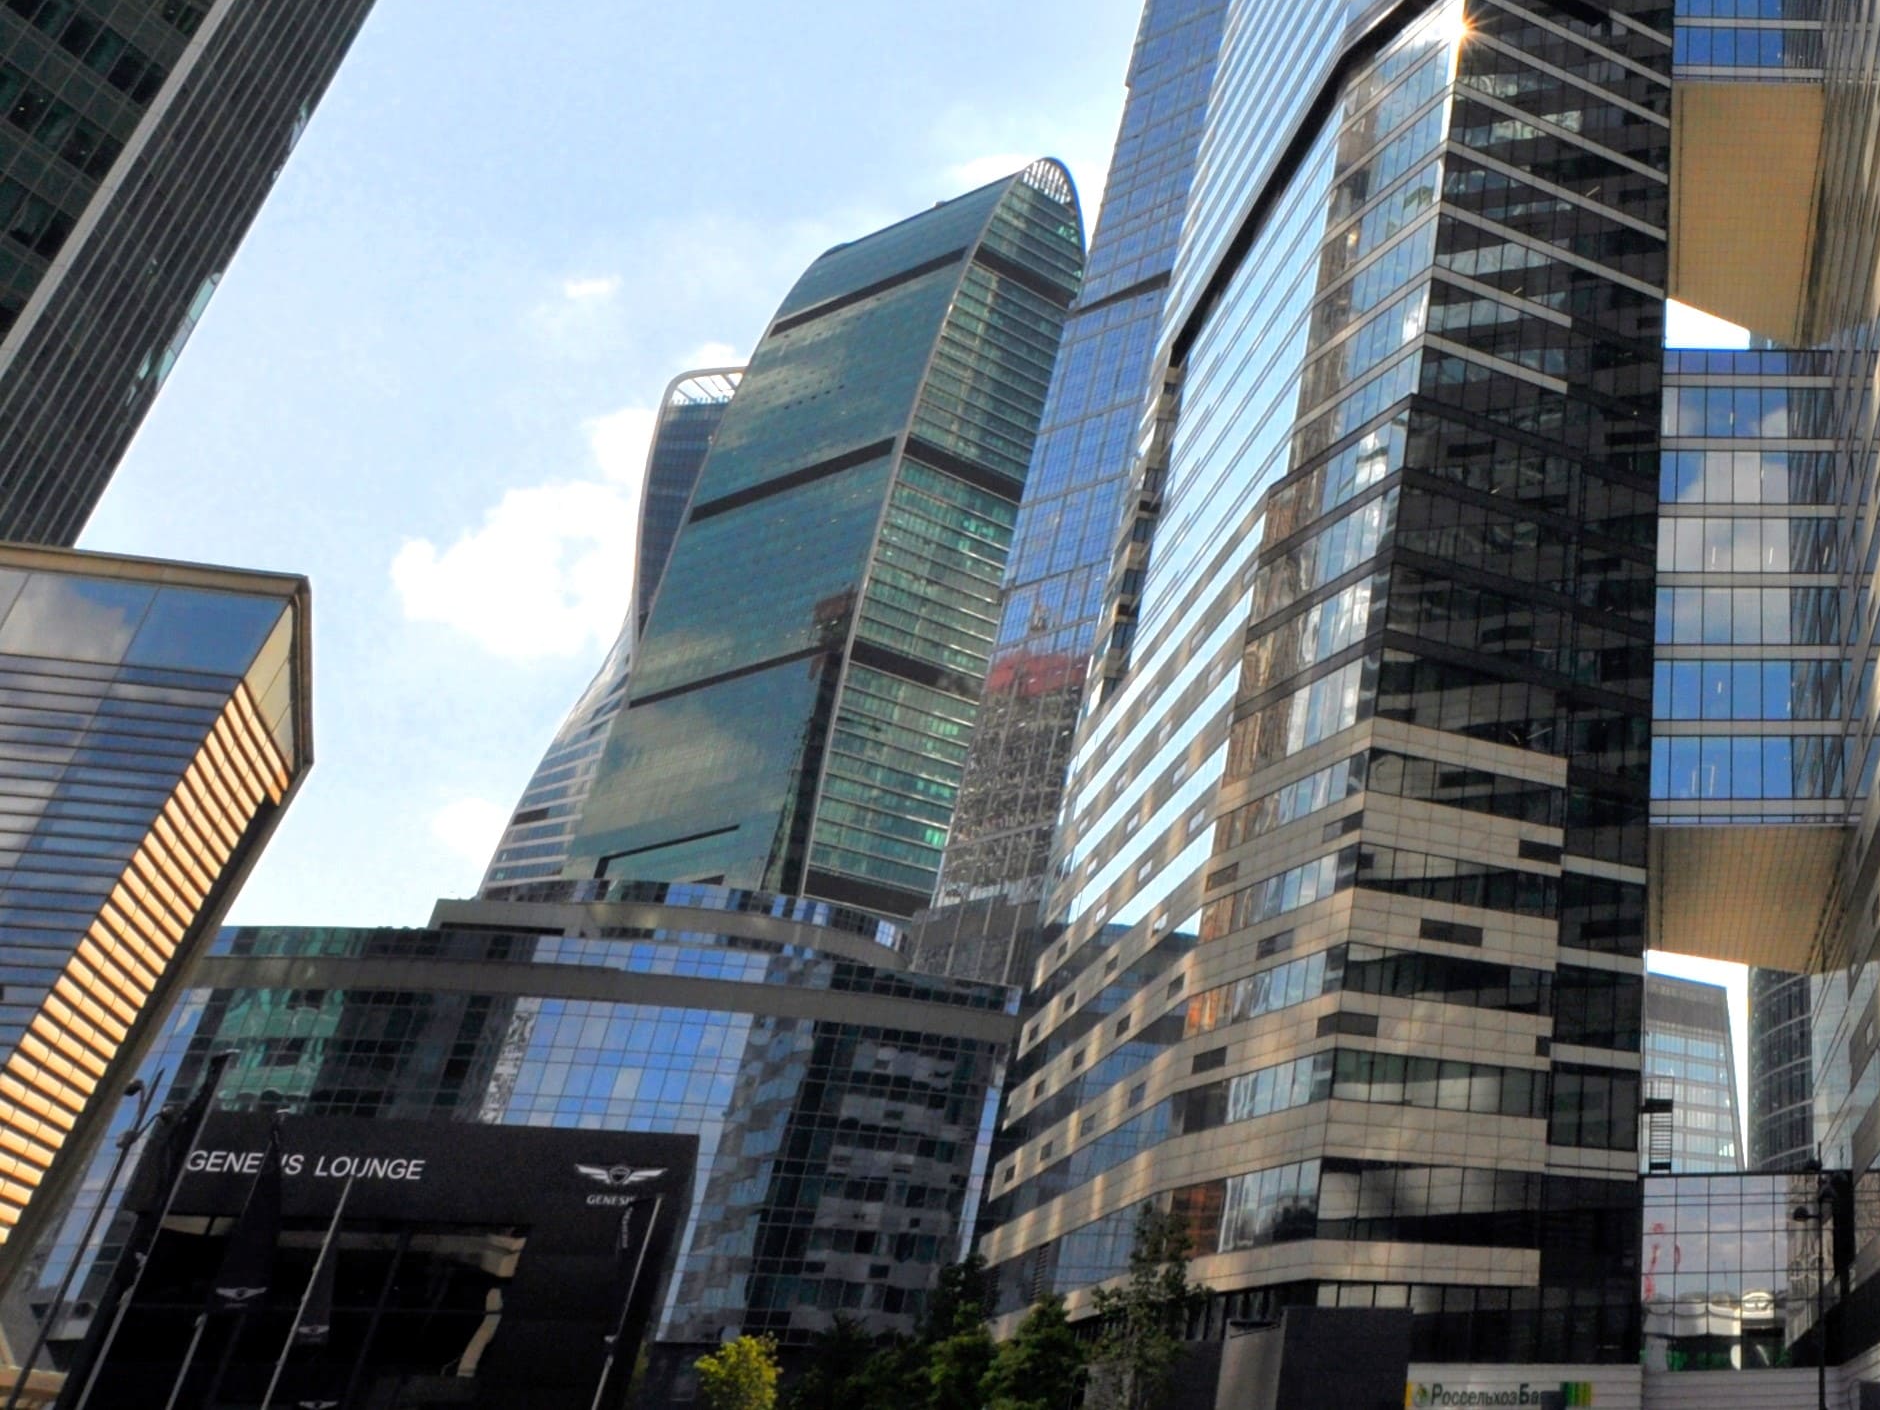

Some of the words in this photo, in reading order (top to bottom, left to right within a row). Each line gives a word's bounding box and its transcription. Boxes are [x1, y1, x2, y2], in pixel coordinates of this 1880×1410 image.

[185, 1149, 305, 1175] GENEIS
[314, 1156, 426, 1181] LOUNGE
[1431, 1382, 1541, 1408] РоссельхозБа
